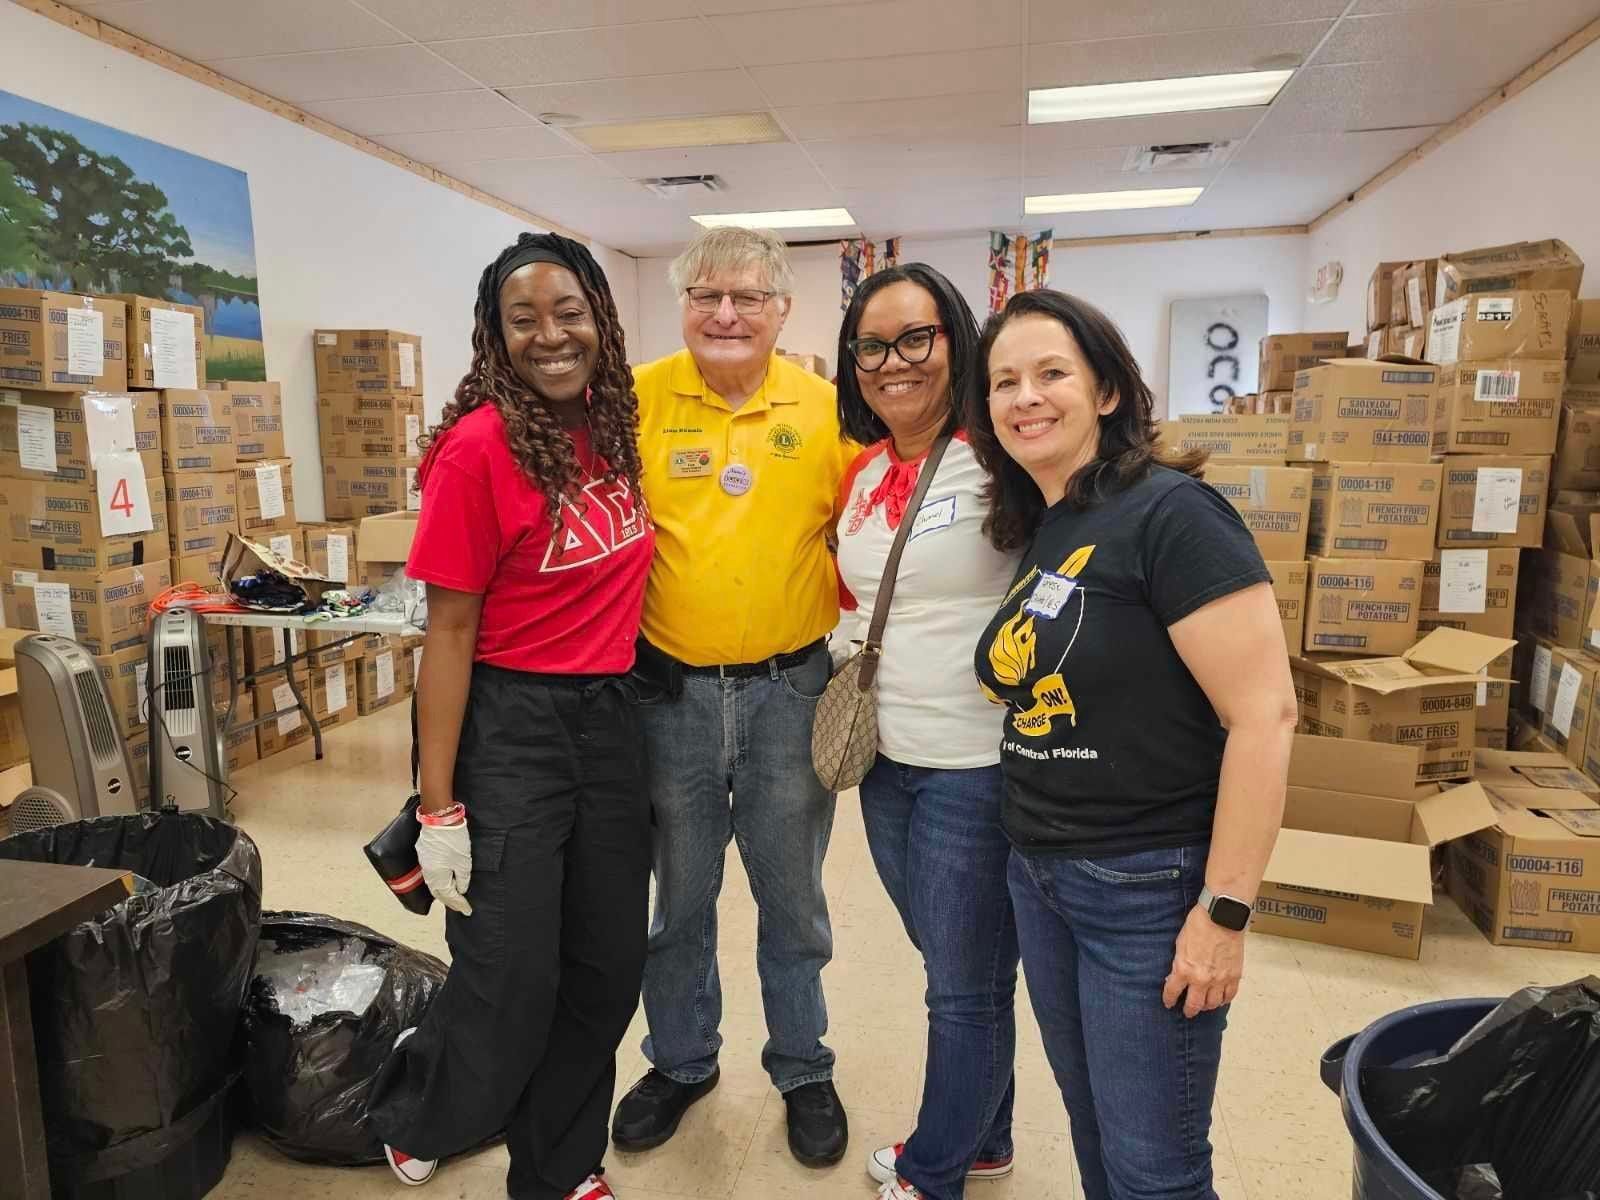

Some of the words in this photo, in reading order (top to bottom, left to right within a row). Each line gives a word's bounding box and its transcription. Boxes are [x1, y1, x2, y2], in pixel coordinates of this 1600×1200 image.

[2, 332, 27, 344] FRIES
[1350, 400, 1391, 408] POTATOES
[1341, 407, 1363, 416] FRIED
[1365, 408, 1398, 417] FRENCH
[1501, 408, 1543, 417] POTATOES
[1376, 431, 1426, 443] 00004-116
[1341, 478, 1392, 489] 00004-116
[110, 479, 134, 517] 4
[48, 499, 88, 511] 00004-116
[1371, 505, 1402, 514] FRENCH
[1404, 506, 1426, 515] FRIED
[1243, 511, 1274, 521] FRENCH
[1276, 512, 1298, 522] FRIED
[1378, 514, 1418, 523] POTATOES
[53, 522, 79, 533] FRIES
[1250, 521, 1290, 530] POTATOES
[1320, 576, 1371, 587] 00004-116
[105, 583, 143, 602] 00004-116
[1350, 602, 1382, 612] FRENCH
[1385, 603, 1407, 613] FRIED
[1358, 611, 1398, 620] POTATOES
[1041, 688, 1067, 708] ON!
[1423, 696, 1471, 712] 00004-849
[1016, 713, 1047, 729] CHARGE
[1400, 726, 1423, 739] MAC
[1427, 724, 1457, 737] FRIES
[1007, 741, 1015, 752] of
[1015, 743, 1049, 760] Central
[1052, 747, 1098, 759] Florida
[1511, 858, 1579, 874] 00004-116
[1552, 891, 1594, 901] FRENCH
[1259, 900, 1323, 921] 00004-116
